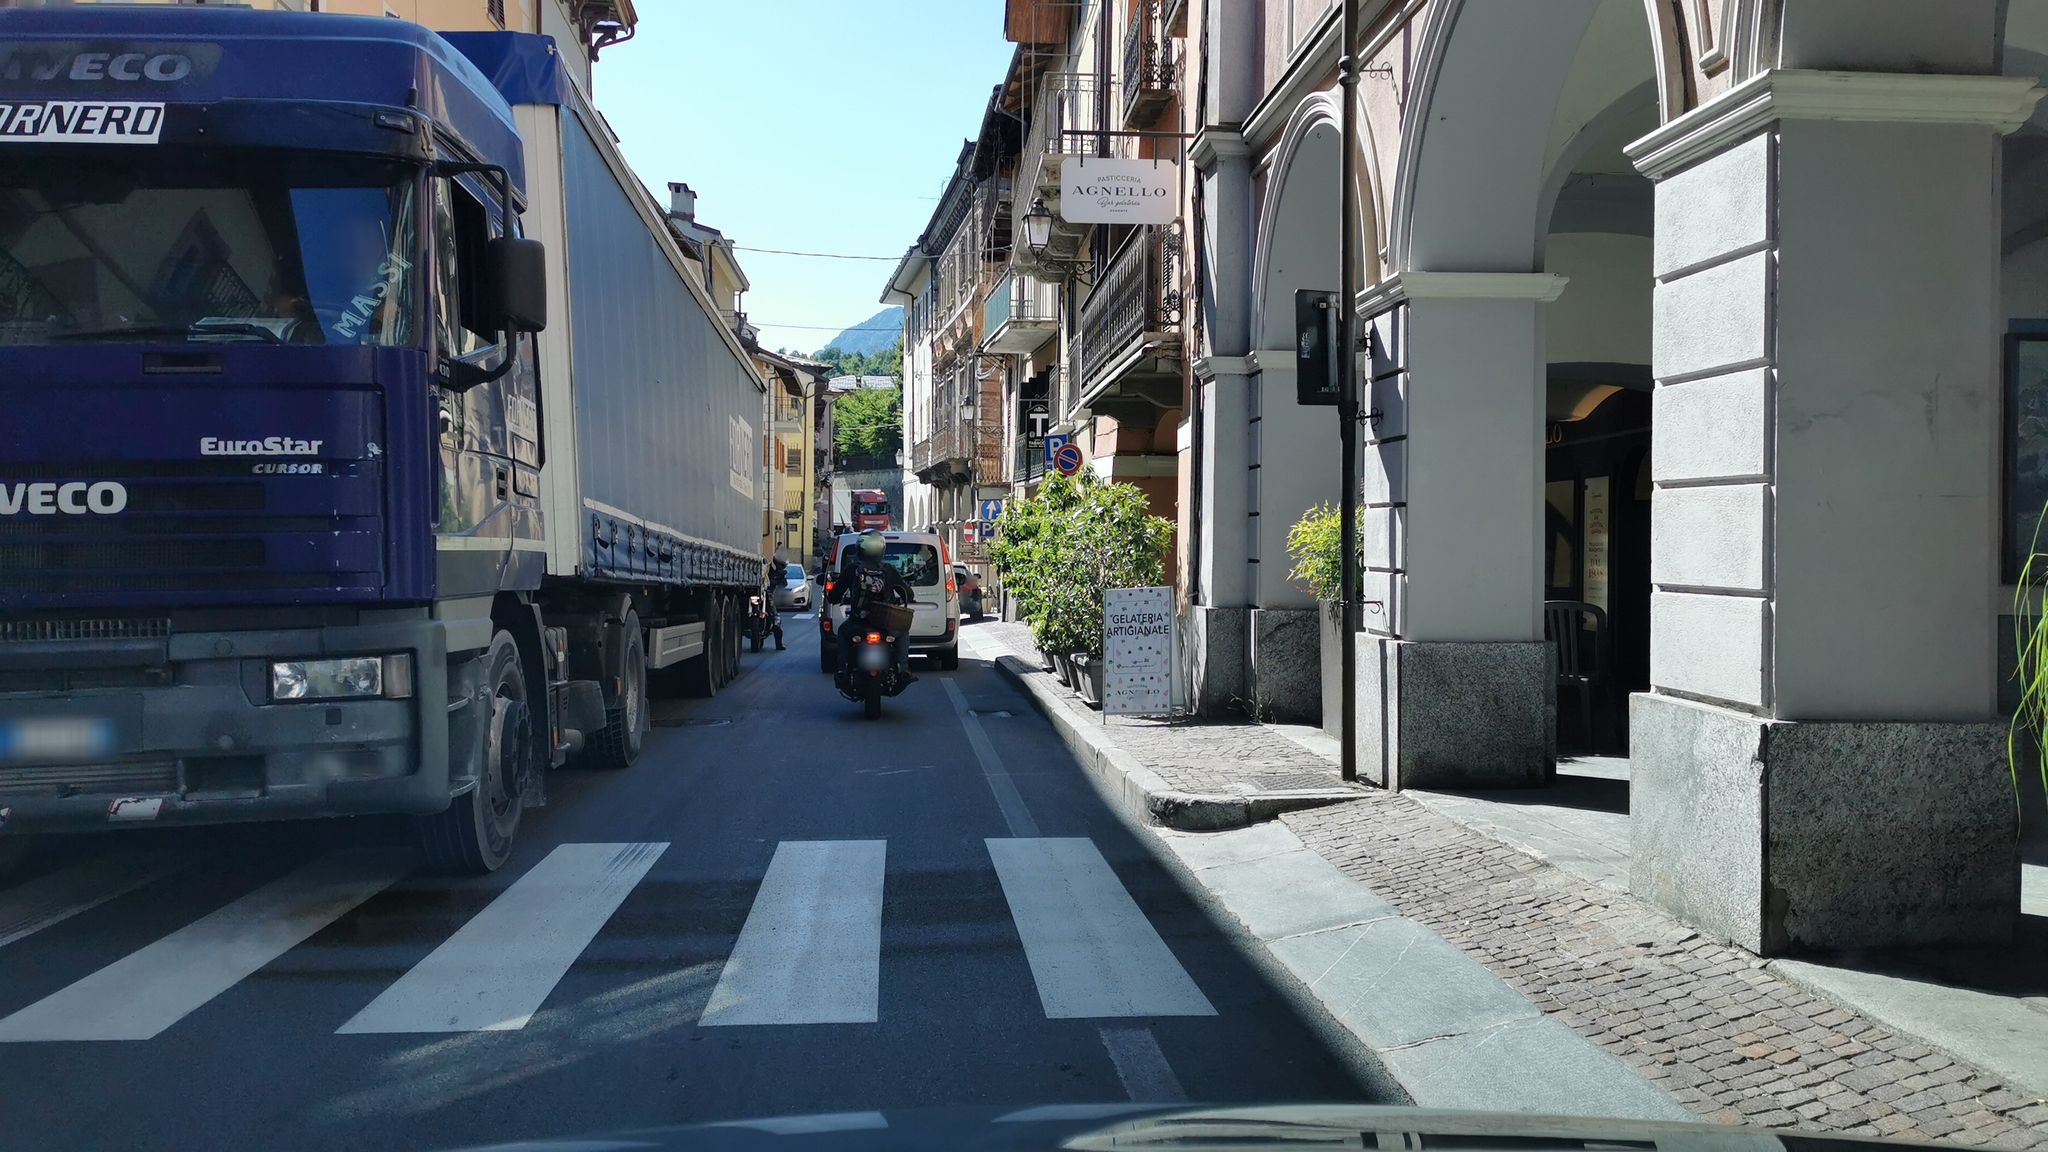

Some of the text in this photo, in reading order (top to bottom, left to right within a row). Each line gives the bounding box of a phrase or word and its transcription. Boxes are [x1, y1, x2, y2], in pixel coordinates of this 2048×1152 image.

[1097, 175, 1142, 184] PASTICCERIA
[1072, 186, 1166, 197] AGNELLO
[1096, 197, 1114, 208] Bar
[332, 252, 413, 338] MASSI
[1029, 413, 1049, 437] T
[200, 437, 323, 455] EuroStar
[1049, 438, 1063, 458] P
[252, 463, 323, 474] CURSOR
[981, 522, 992, 536] P
[1112, 612, 1164, 624] GELATERIA
[1106, 624, 1169, 637] ARTIGIANALE
[1115, 688, 1160, 696] AGNLO
